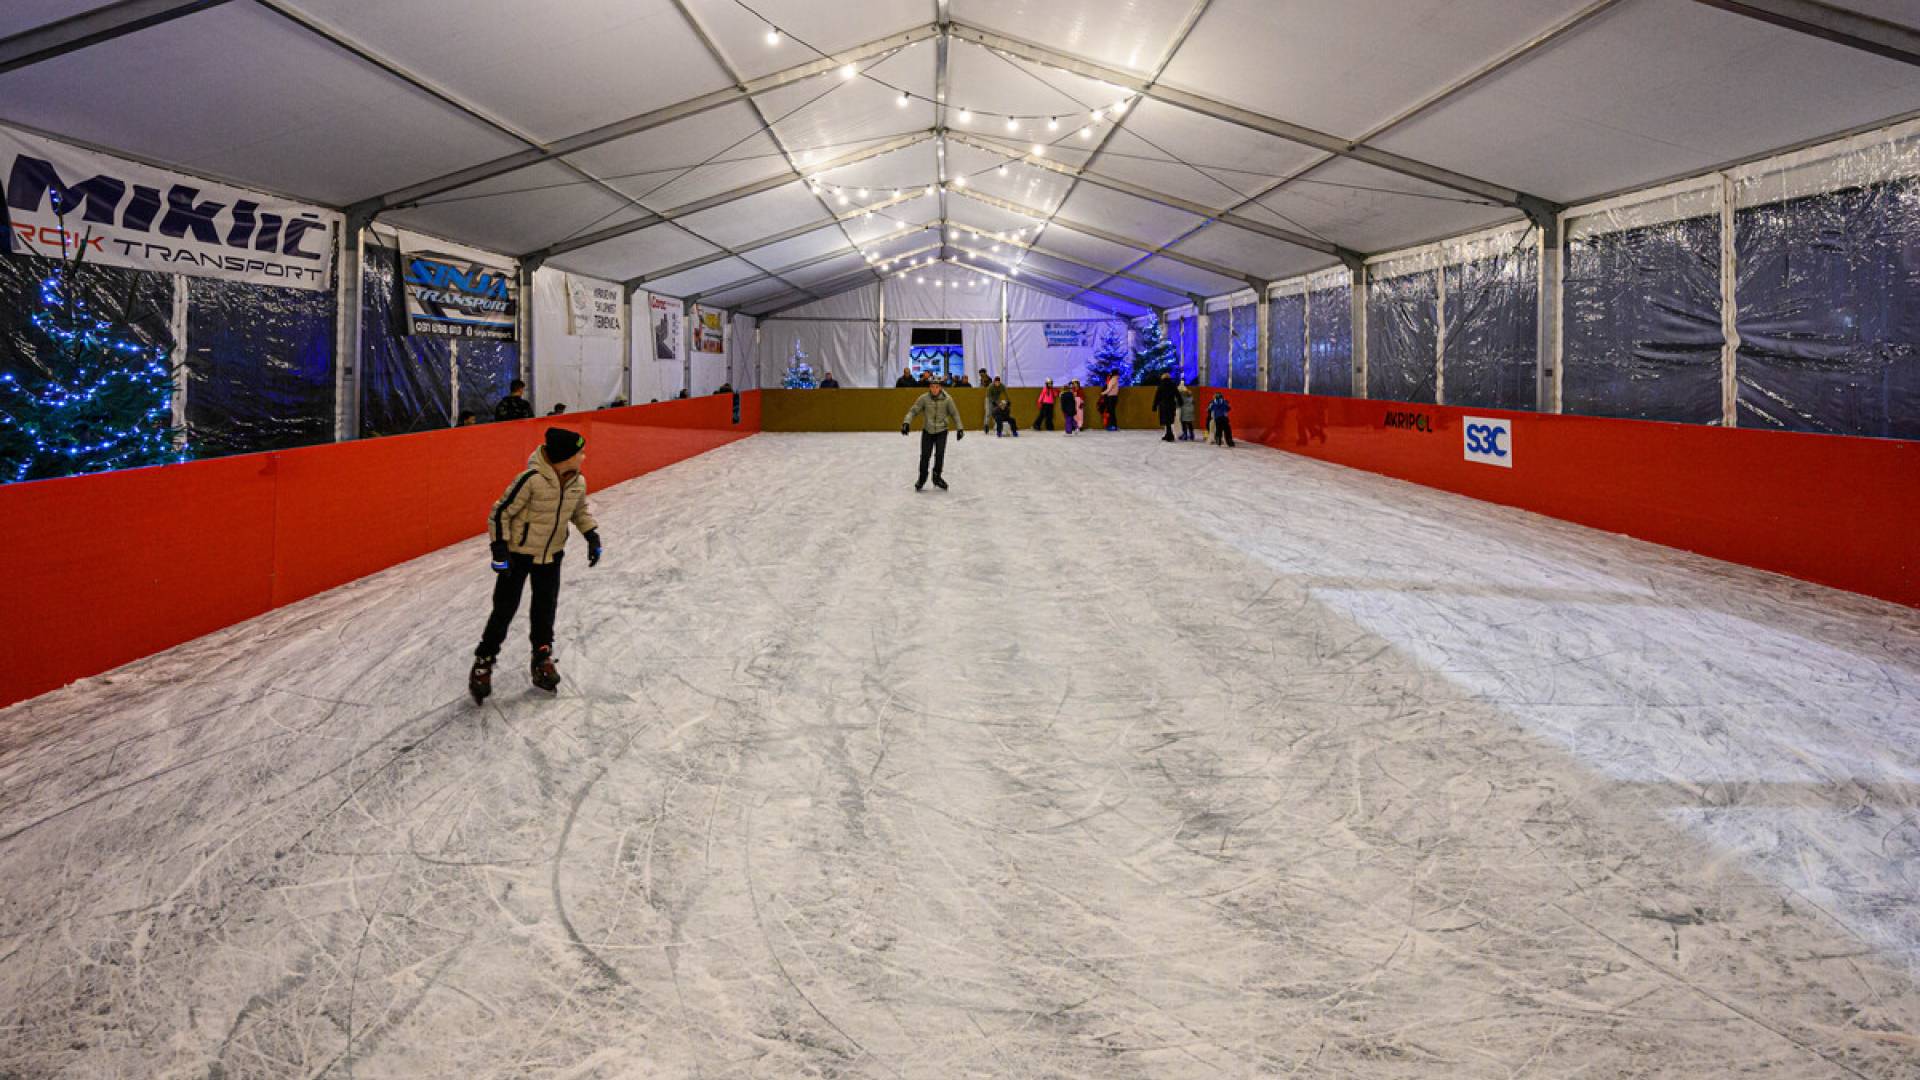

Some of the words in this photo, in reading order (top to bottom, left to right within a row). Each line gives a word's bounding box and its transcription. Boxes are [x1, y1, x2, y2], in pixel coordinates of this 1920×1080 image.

[113, 238, 323, 281] TRANSPORT
[415, 286, 510, 312] TRANSPORT
[1384, 411, 1433, 433] AKRIPOL
[1466, 423, 1508, 457] S3C
